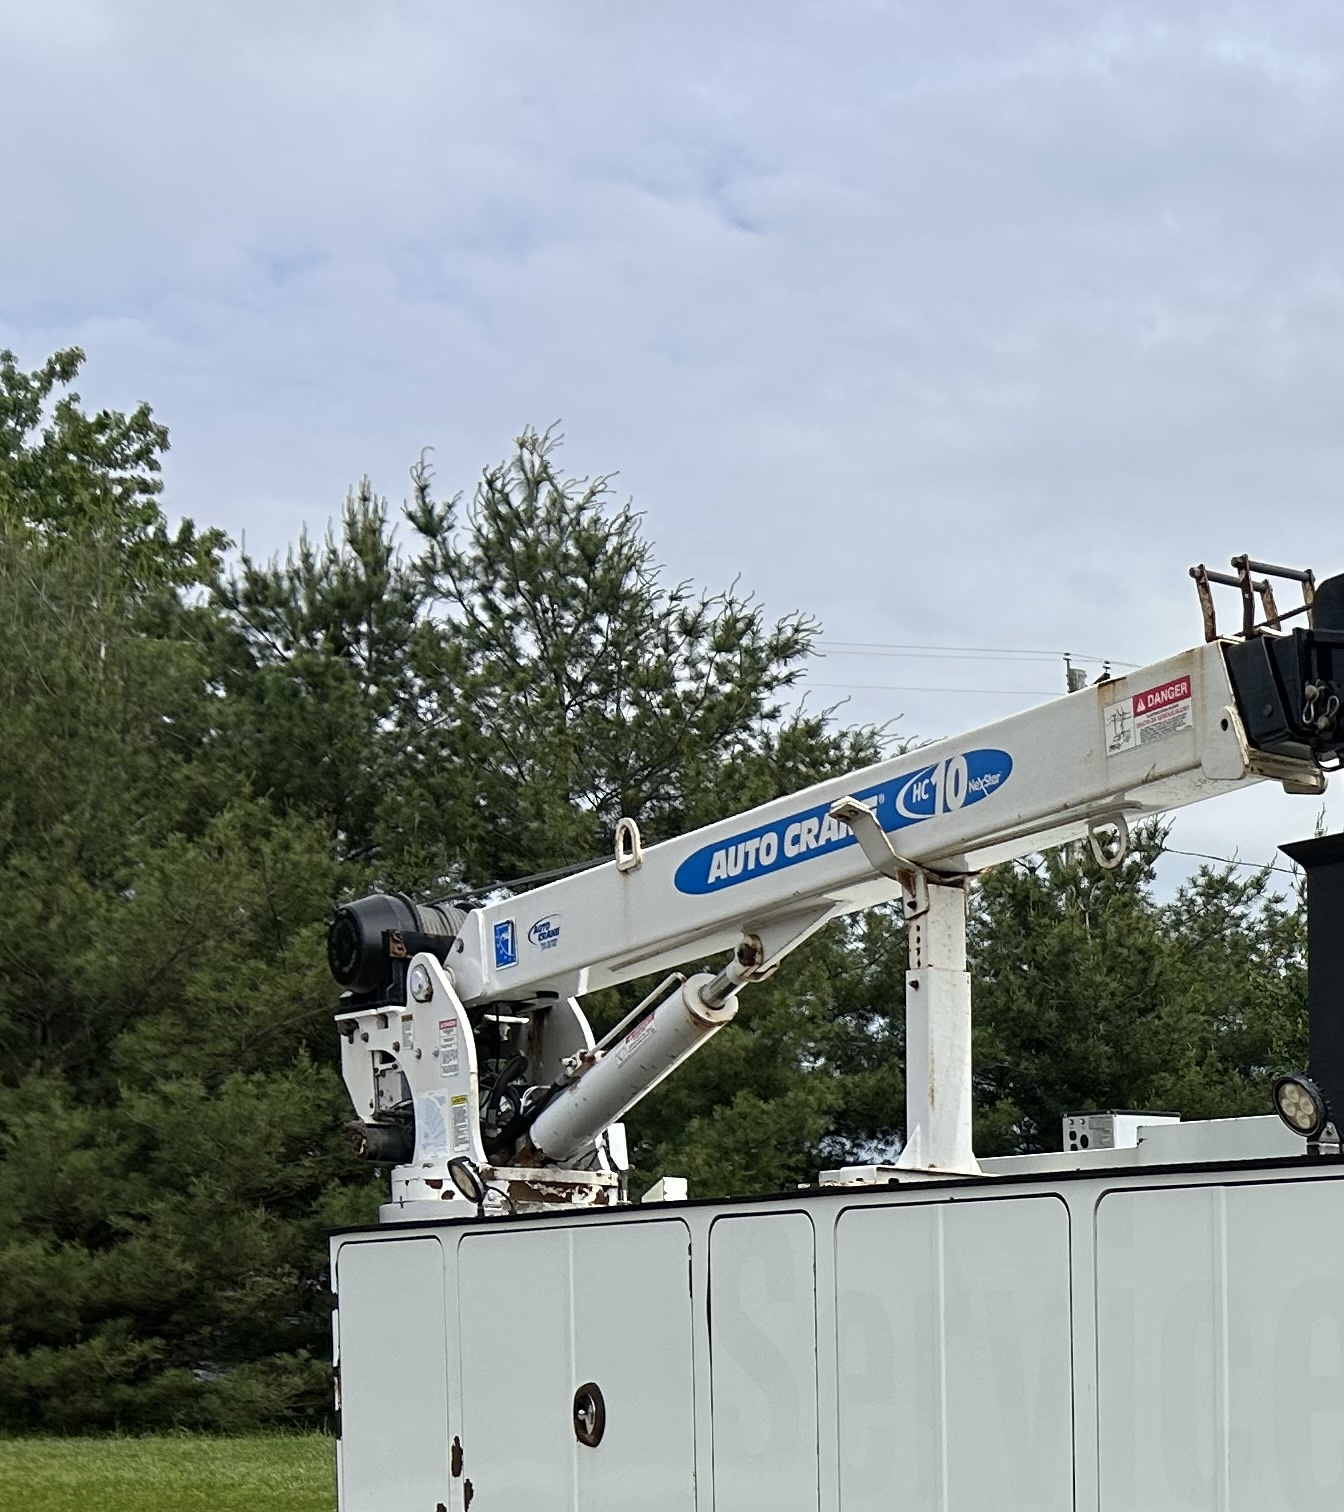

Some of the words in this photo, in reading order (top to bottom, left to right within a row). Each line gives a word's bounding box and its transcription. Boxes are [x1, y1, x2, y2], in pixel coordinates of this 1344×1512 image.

[1147, 682, 1188, 707] DANGER
[912, 778, 930, 804] HC
[930, 755, 968, 815] 10
[707, 831, 779, 884] AUTO
